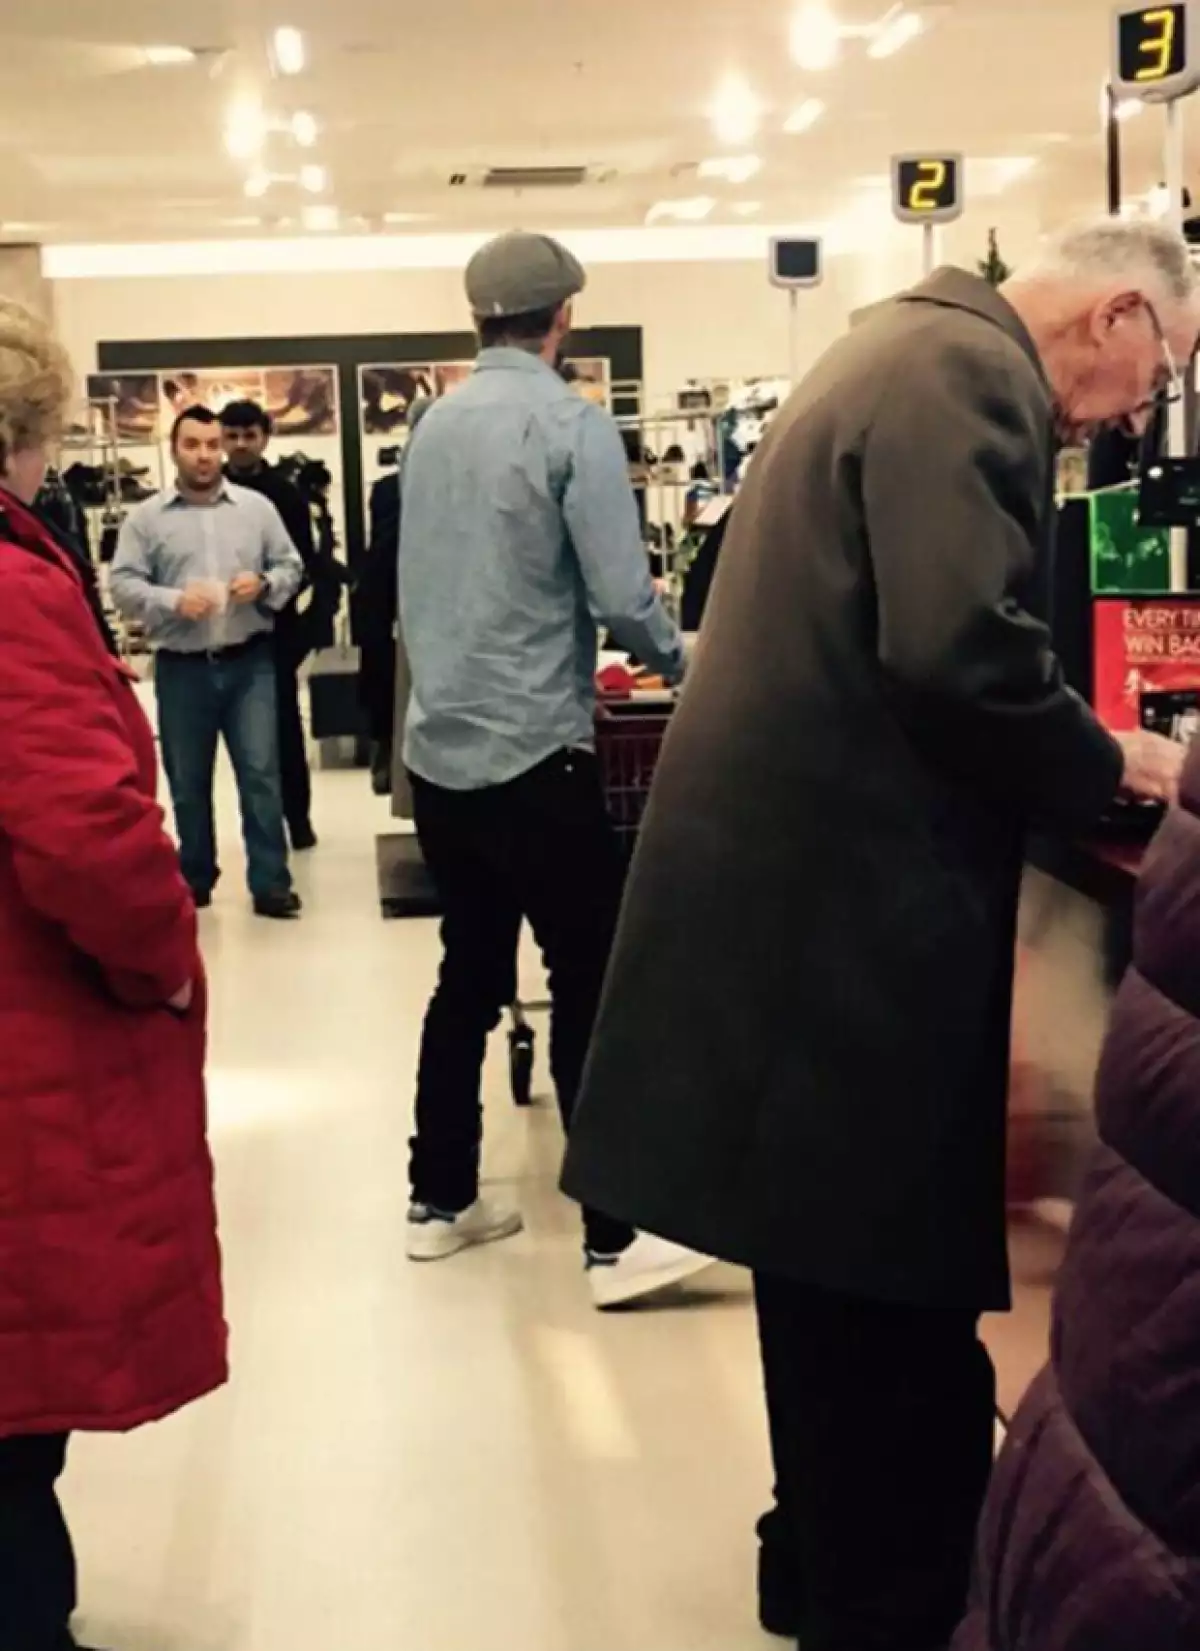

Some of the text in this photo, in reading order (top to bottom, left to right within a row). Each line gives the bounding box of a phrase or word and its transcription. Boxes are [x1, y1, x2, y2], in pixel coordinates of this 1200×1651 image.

[1133, 9, 1174, 81] 3
[908, 161, 945, 210] 2
[1123, 608, 1177, 629] EVERY
[1123, 633, 1164, 654] WIN
